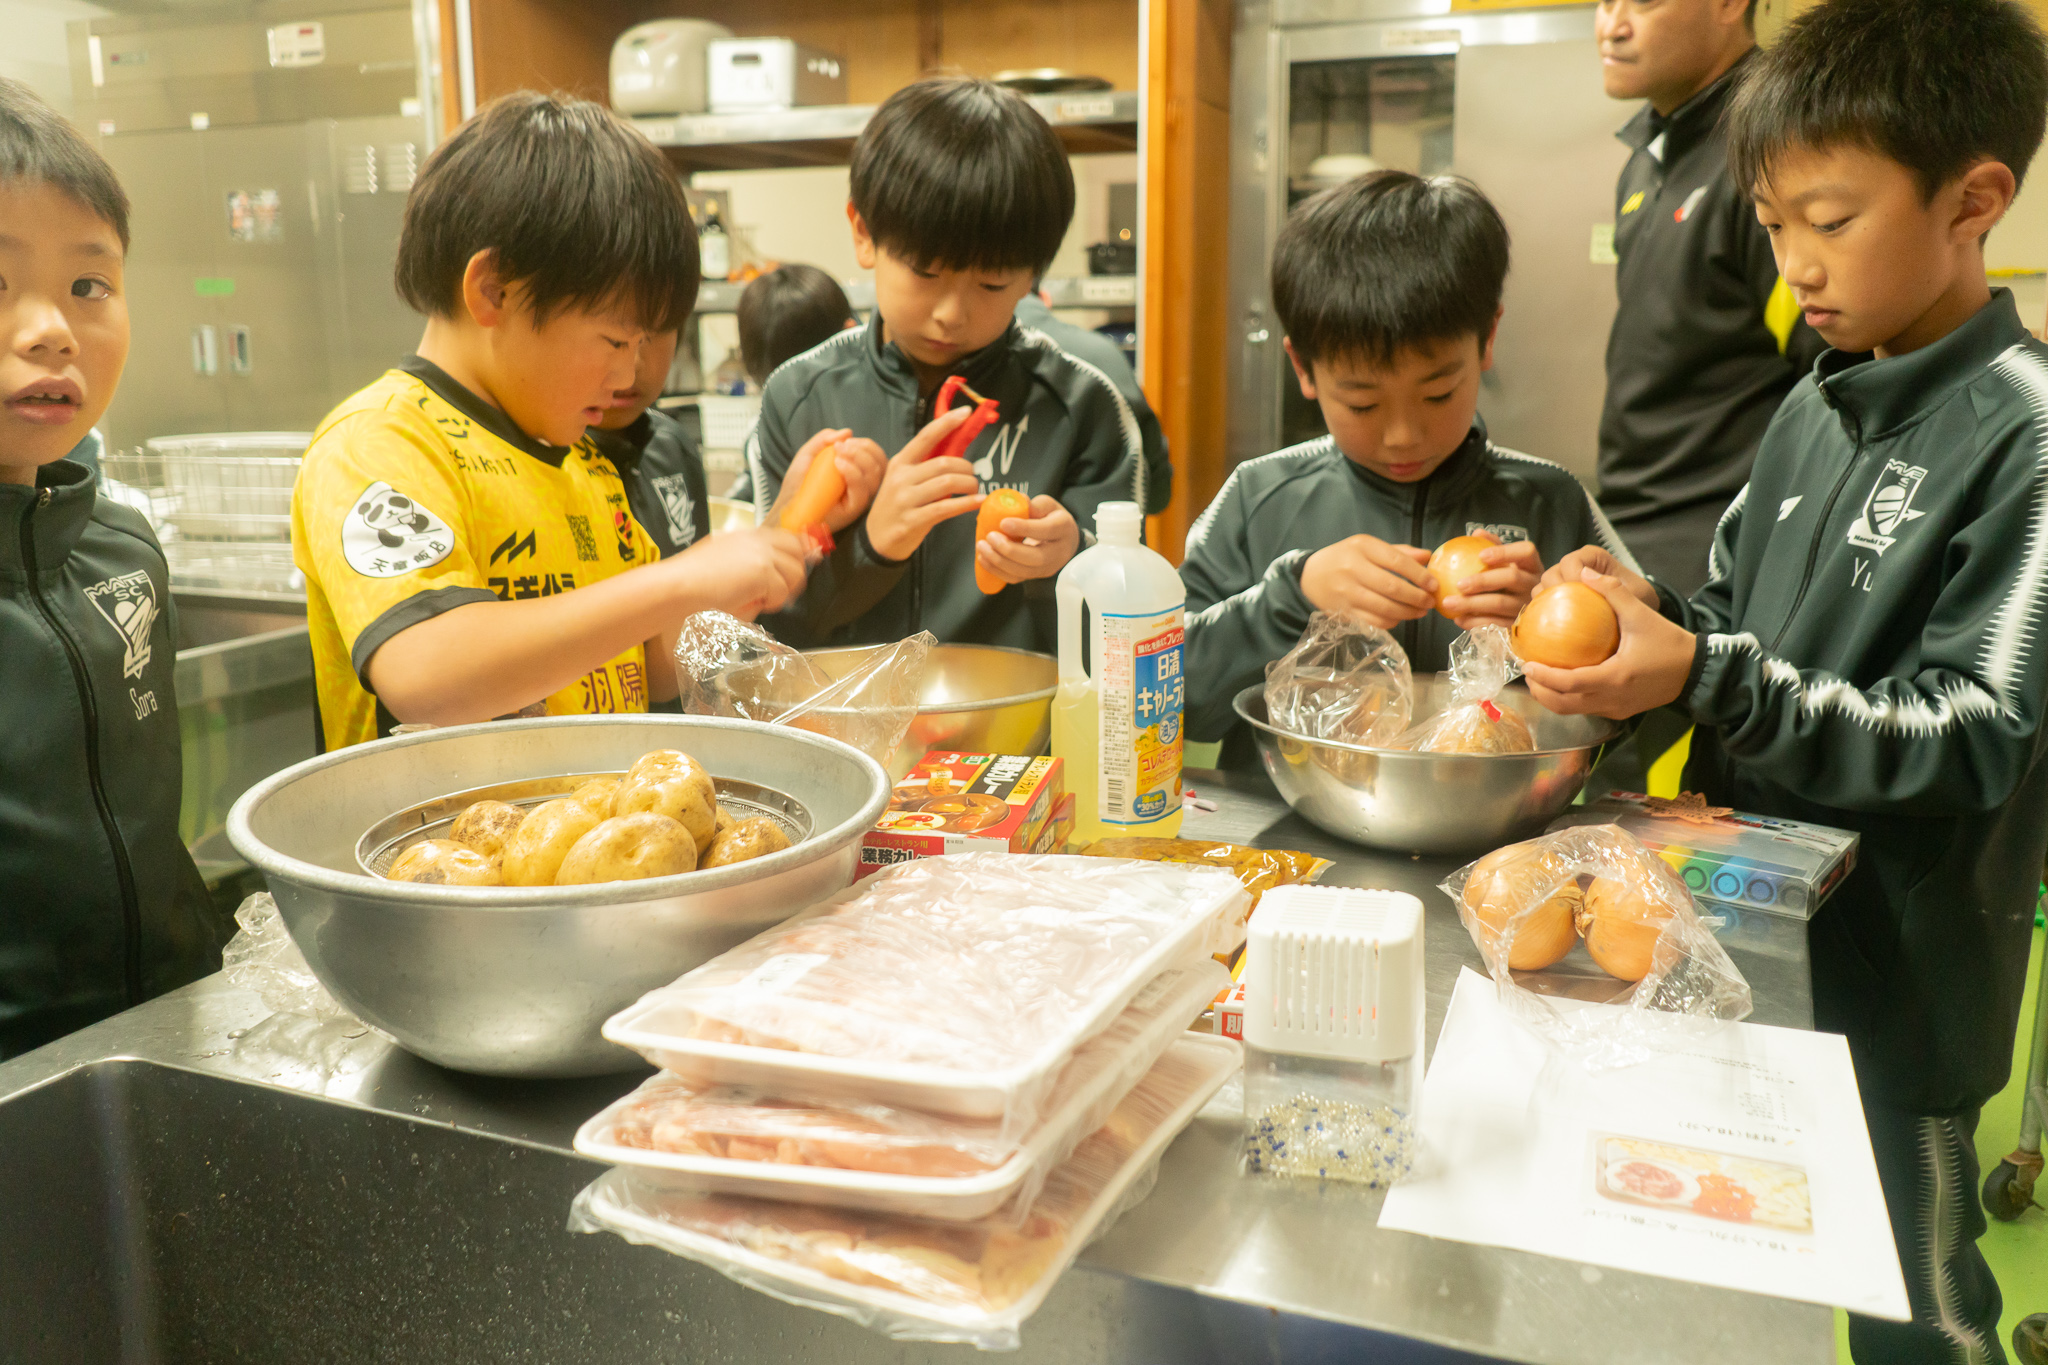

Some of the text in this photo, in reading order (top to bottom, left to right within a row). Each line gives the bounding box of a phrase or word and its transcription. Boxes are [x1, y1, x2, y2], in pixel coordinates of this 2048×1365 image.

[86, 571, 149, 600] MATE
[114, 586, 143, 601] SC
[1158, 649, 1180, 681] 日清
[130, 688, 158, 720] Sora
[581, 662, 642, 714] 羽陽
